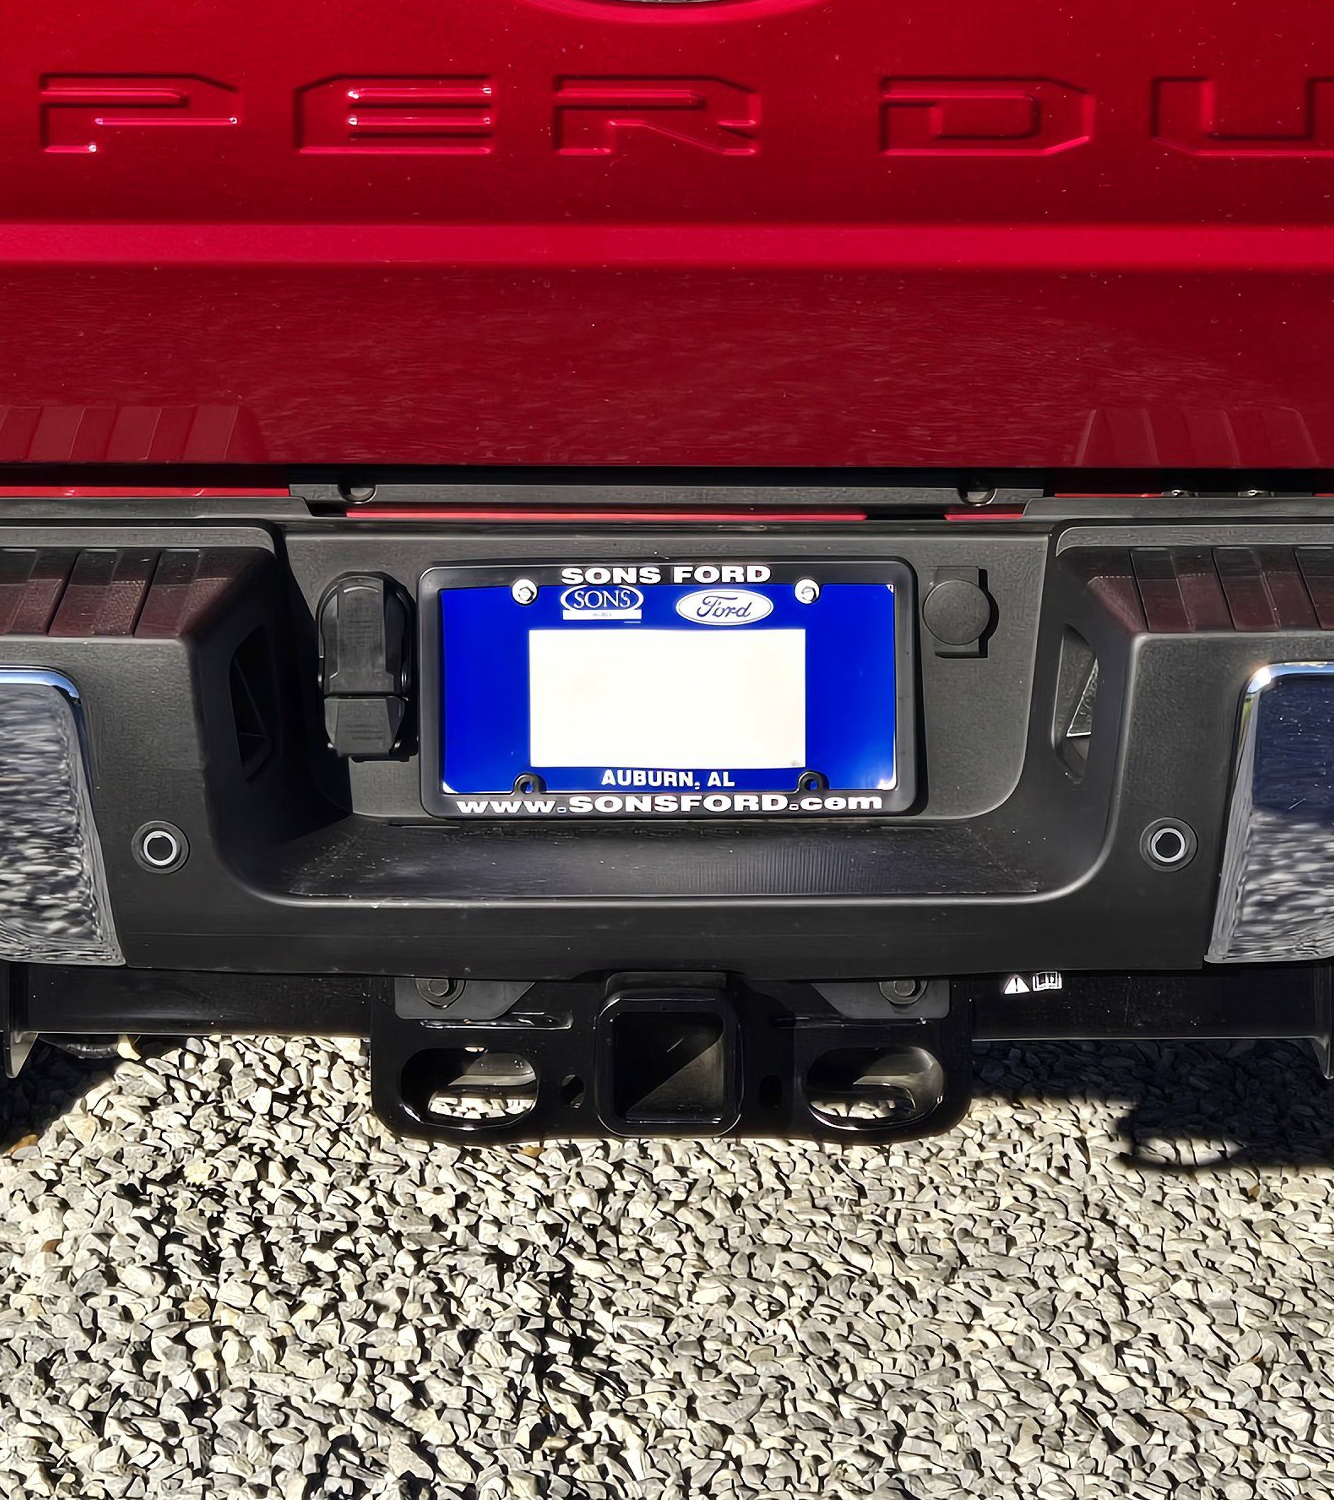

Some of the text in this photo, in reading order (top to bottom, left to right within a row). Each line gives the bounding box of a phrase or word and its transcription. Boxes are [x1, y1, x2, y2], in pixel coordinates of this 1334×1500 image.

[560, 564, 772, 586] SONS FORD
[572, 588, 632, 610] SONS
[696, 595, 752, 618] Ford
[600, 769, 736, 790] AUBURN, AL
[455, 793, 884, 815] www.SONSFORD.com
